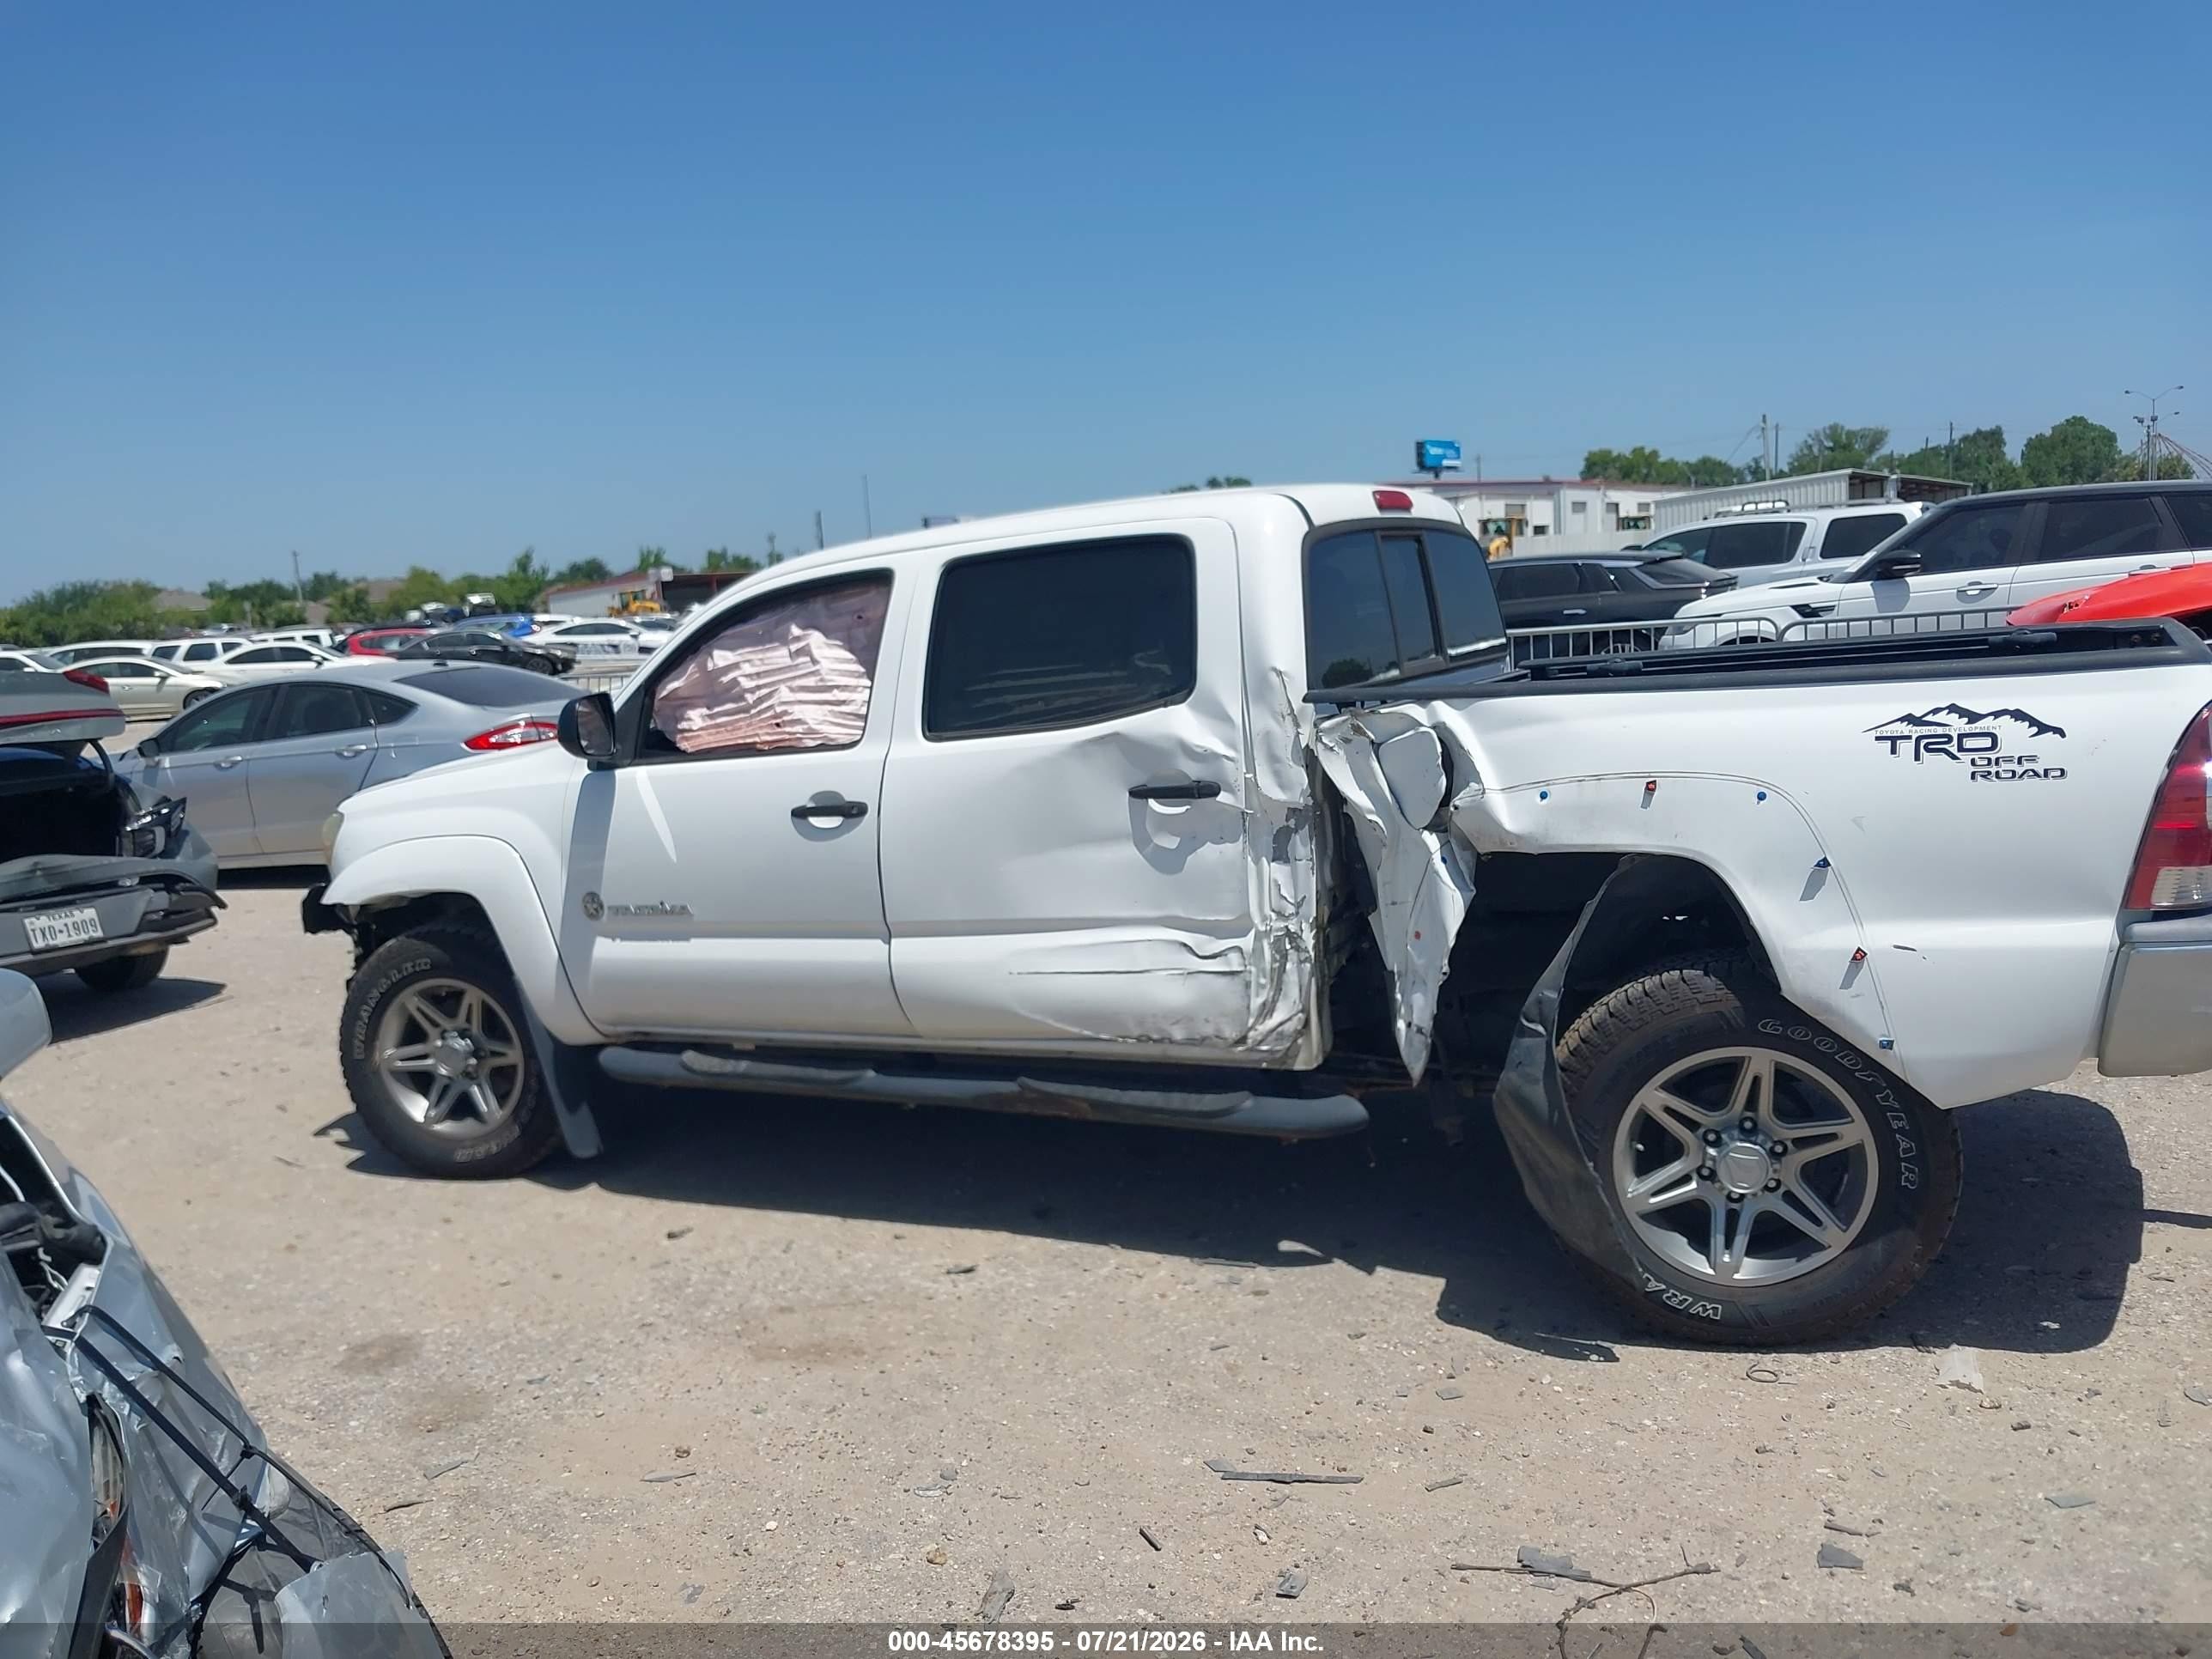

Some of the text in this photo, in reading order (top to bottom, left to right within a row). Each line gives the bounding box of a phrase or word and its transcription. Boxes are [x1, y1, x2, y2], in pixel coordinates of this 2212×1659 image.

[1942, 725, 2002, 733] DEVELOPMENT
[1875, 732, 2002, 764] TRD
[1970, 755, 2040, 768] OFF
[1970, 768, 2068, 782] ROAD
[46, 910, 76, 921] TEXAS
[1758, 1018, 1919, 1189] GOODYEAR
